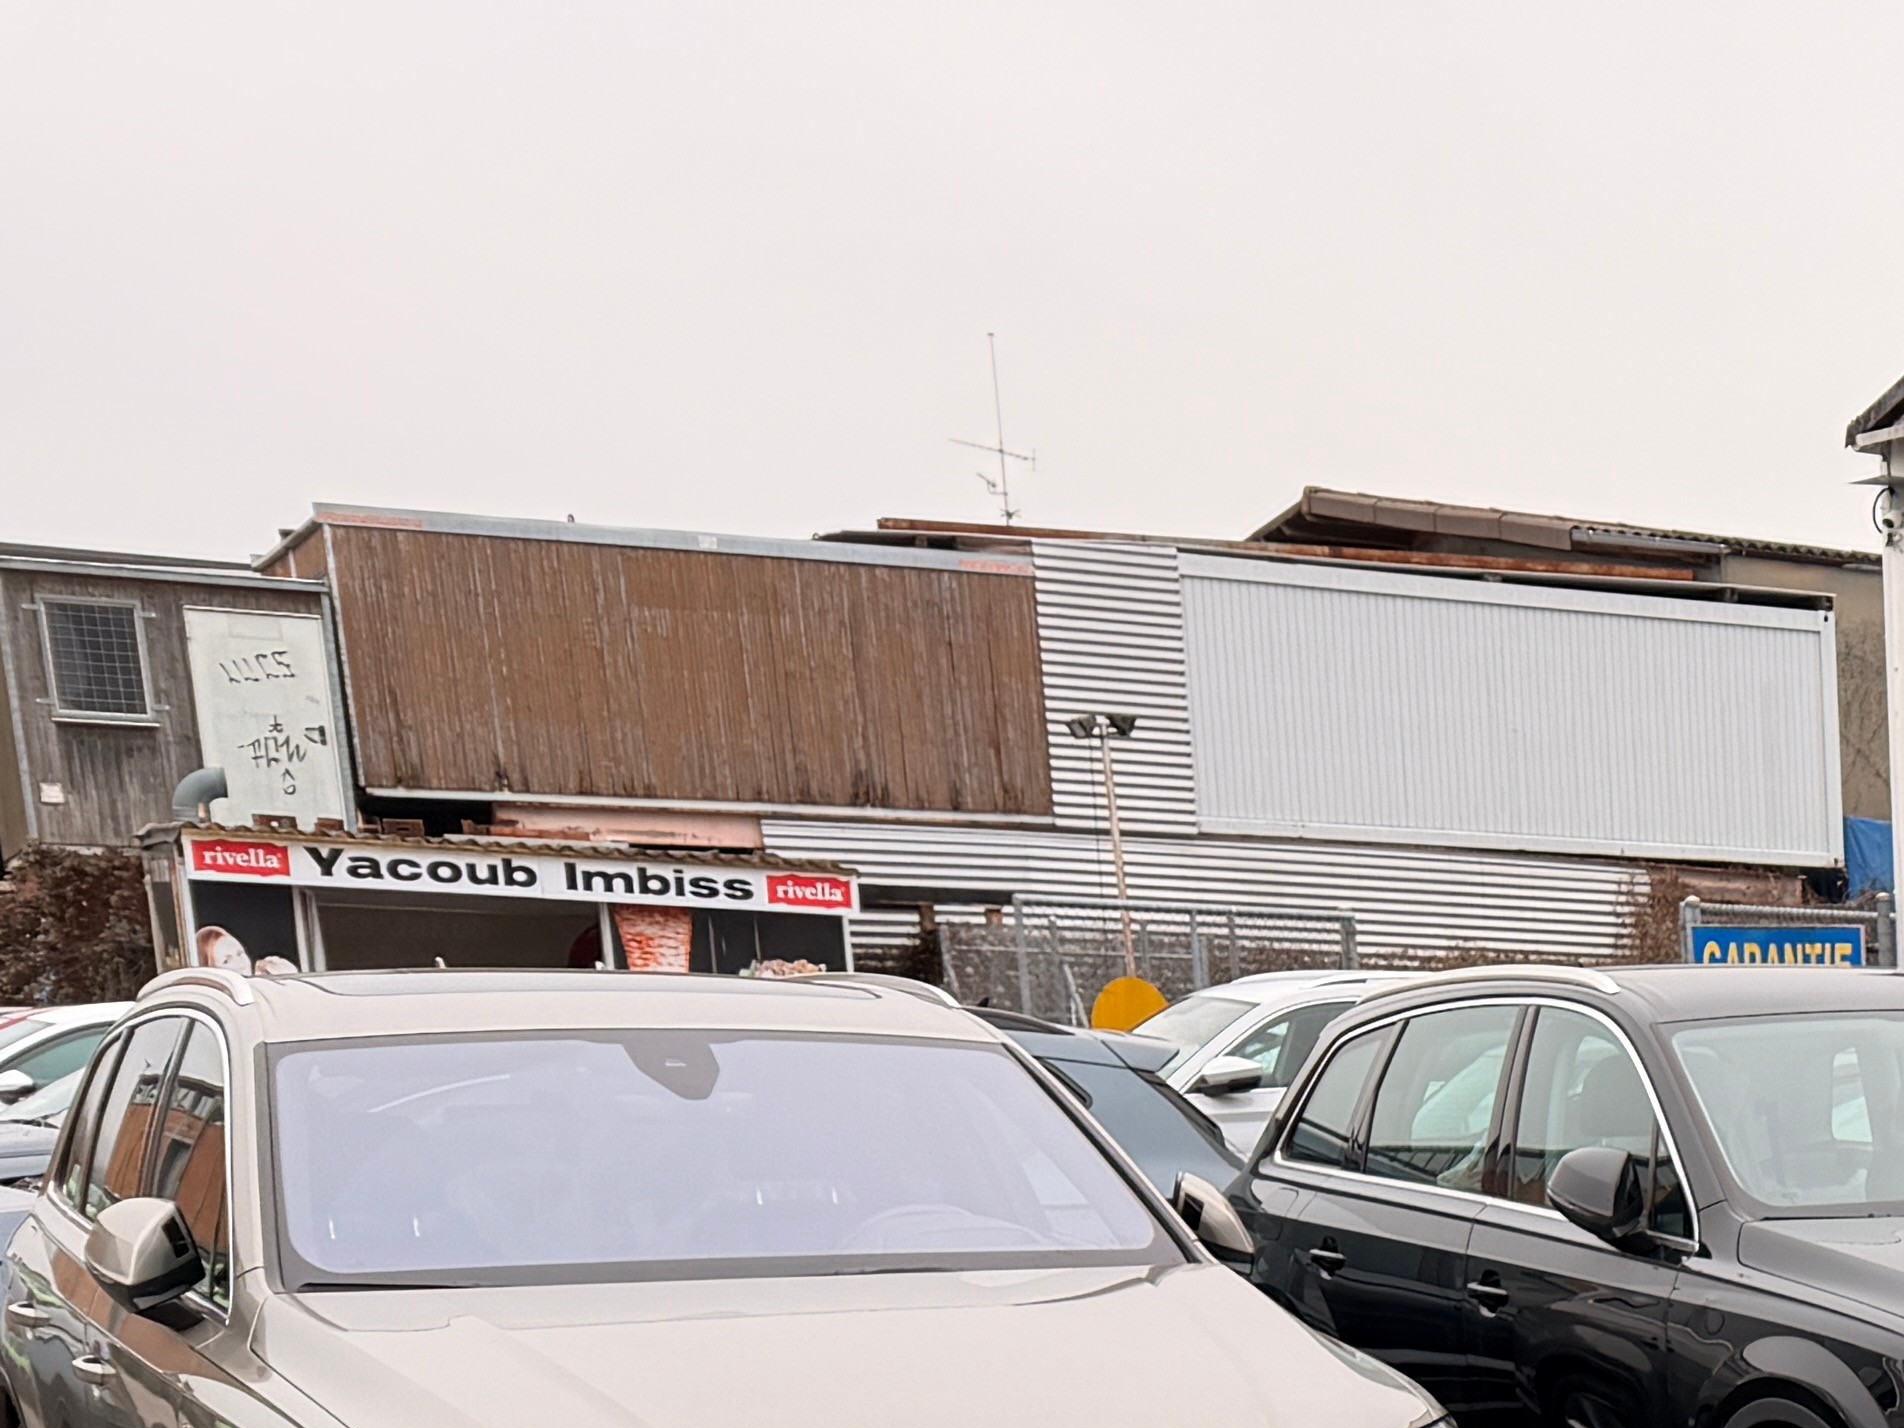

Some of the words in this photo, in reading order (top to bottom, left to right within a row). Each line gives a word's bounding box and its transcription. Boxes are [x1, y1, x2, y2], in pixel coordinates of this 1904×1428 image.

[202, 845, 281, 869] rivella
[302, 846, 540, 890] Yacoub
[563, 861, 757, 902] Imbiss
[774, 879, 850, 905] rivella
